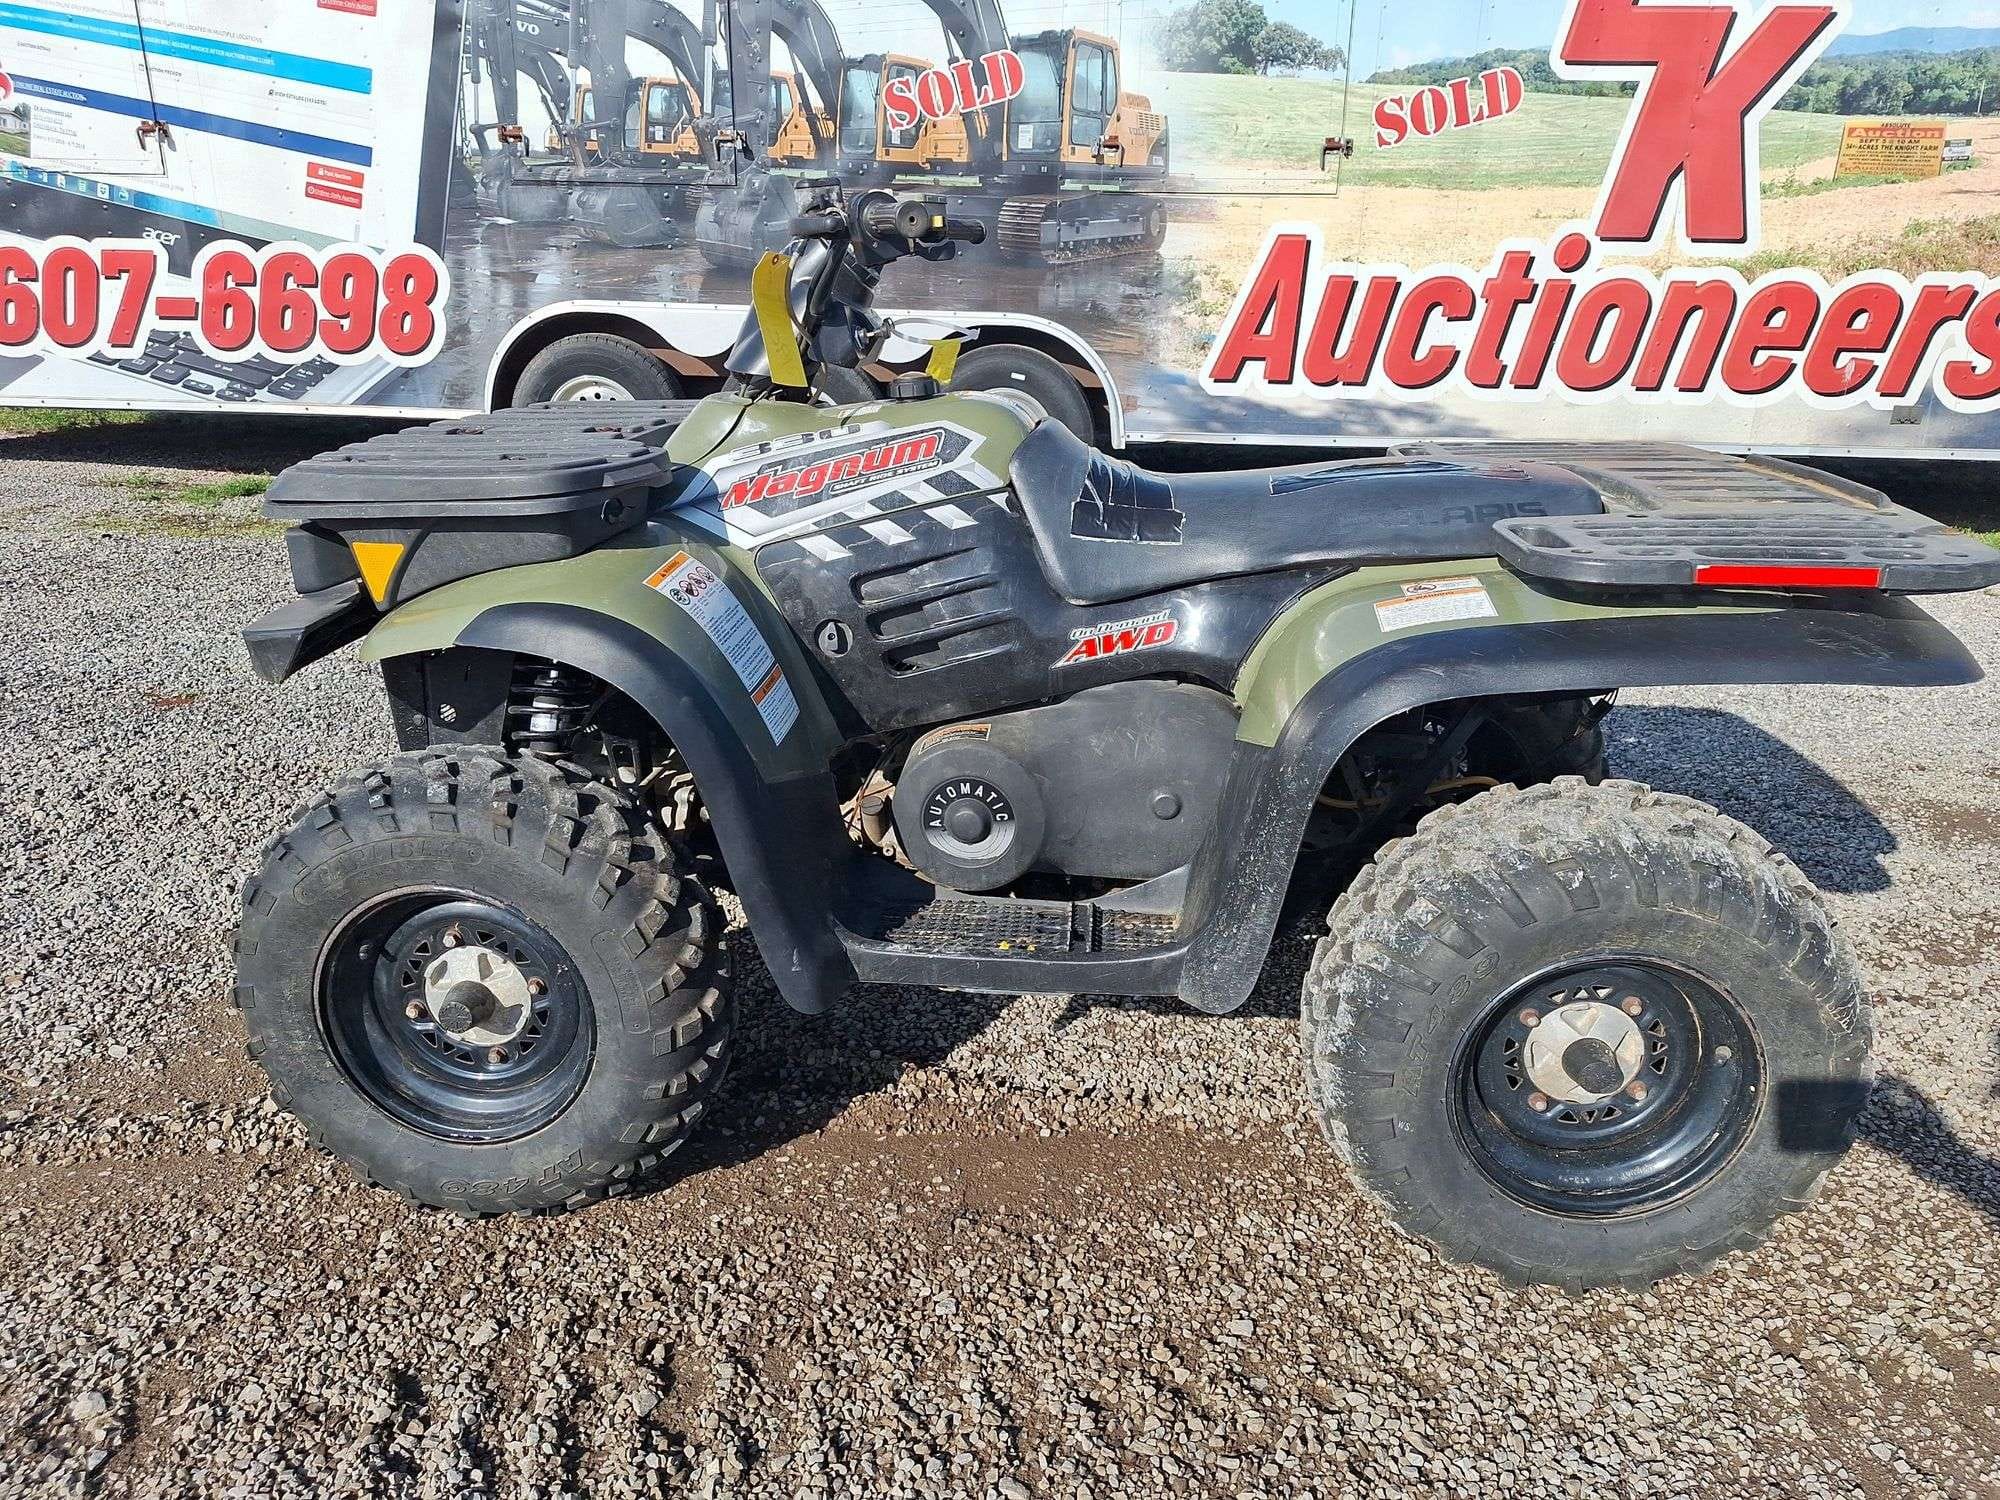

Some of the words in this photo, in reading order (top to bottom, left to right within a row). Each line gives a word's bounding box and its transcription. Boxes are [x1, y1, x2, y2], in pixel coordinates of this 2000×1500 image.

[884, 51, 1024, 130] SOLD
[1374, 68, 1522, 148] SOLD
[1850, 128, 1940, 138] Auction
[142, 226, 181, 246] acer
[0, 246, 438, 354] 607-6698
[1209, 232, 2000, 399] Auctioneers
[720, 433, 942, 512] Magnum
[1056, 618, 1178, 664] AWD
[929, 782, 1009, 828] AUTOMATIC
